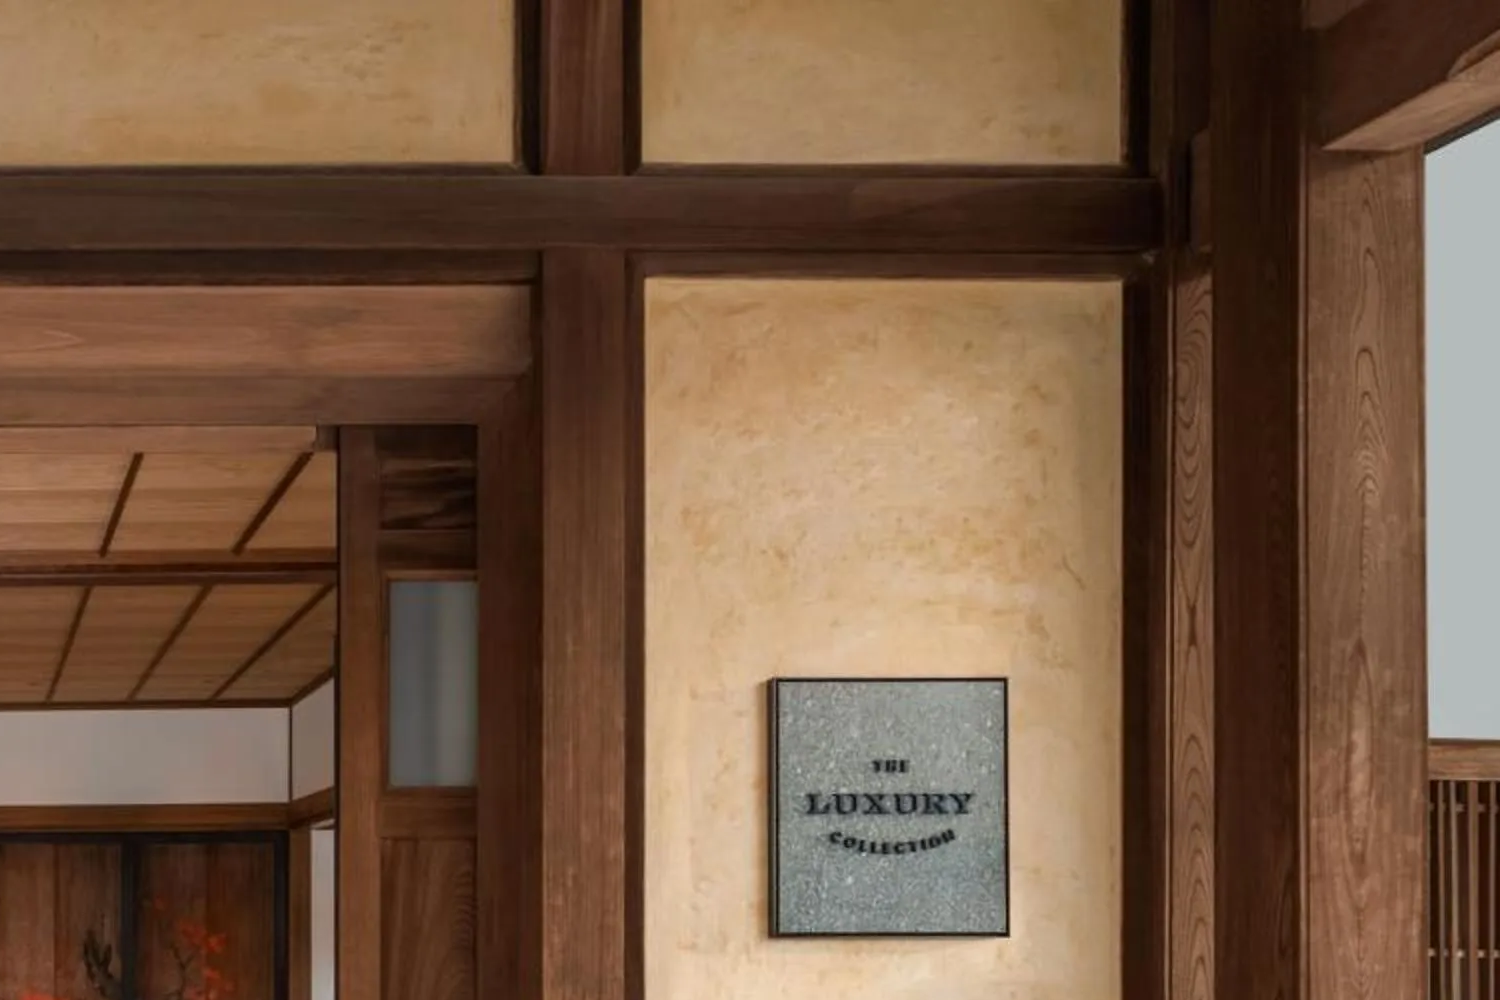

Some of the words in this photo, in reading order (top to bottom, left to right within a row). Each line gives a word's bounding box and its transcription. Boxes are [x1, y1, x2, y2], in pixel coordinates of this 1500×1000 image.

[871, 759, 910, 773] THE
[805, 793, 975, 815] LUXURY
[828, 828, 956, 855] COLLECTION
